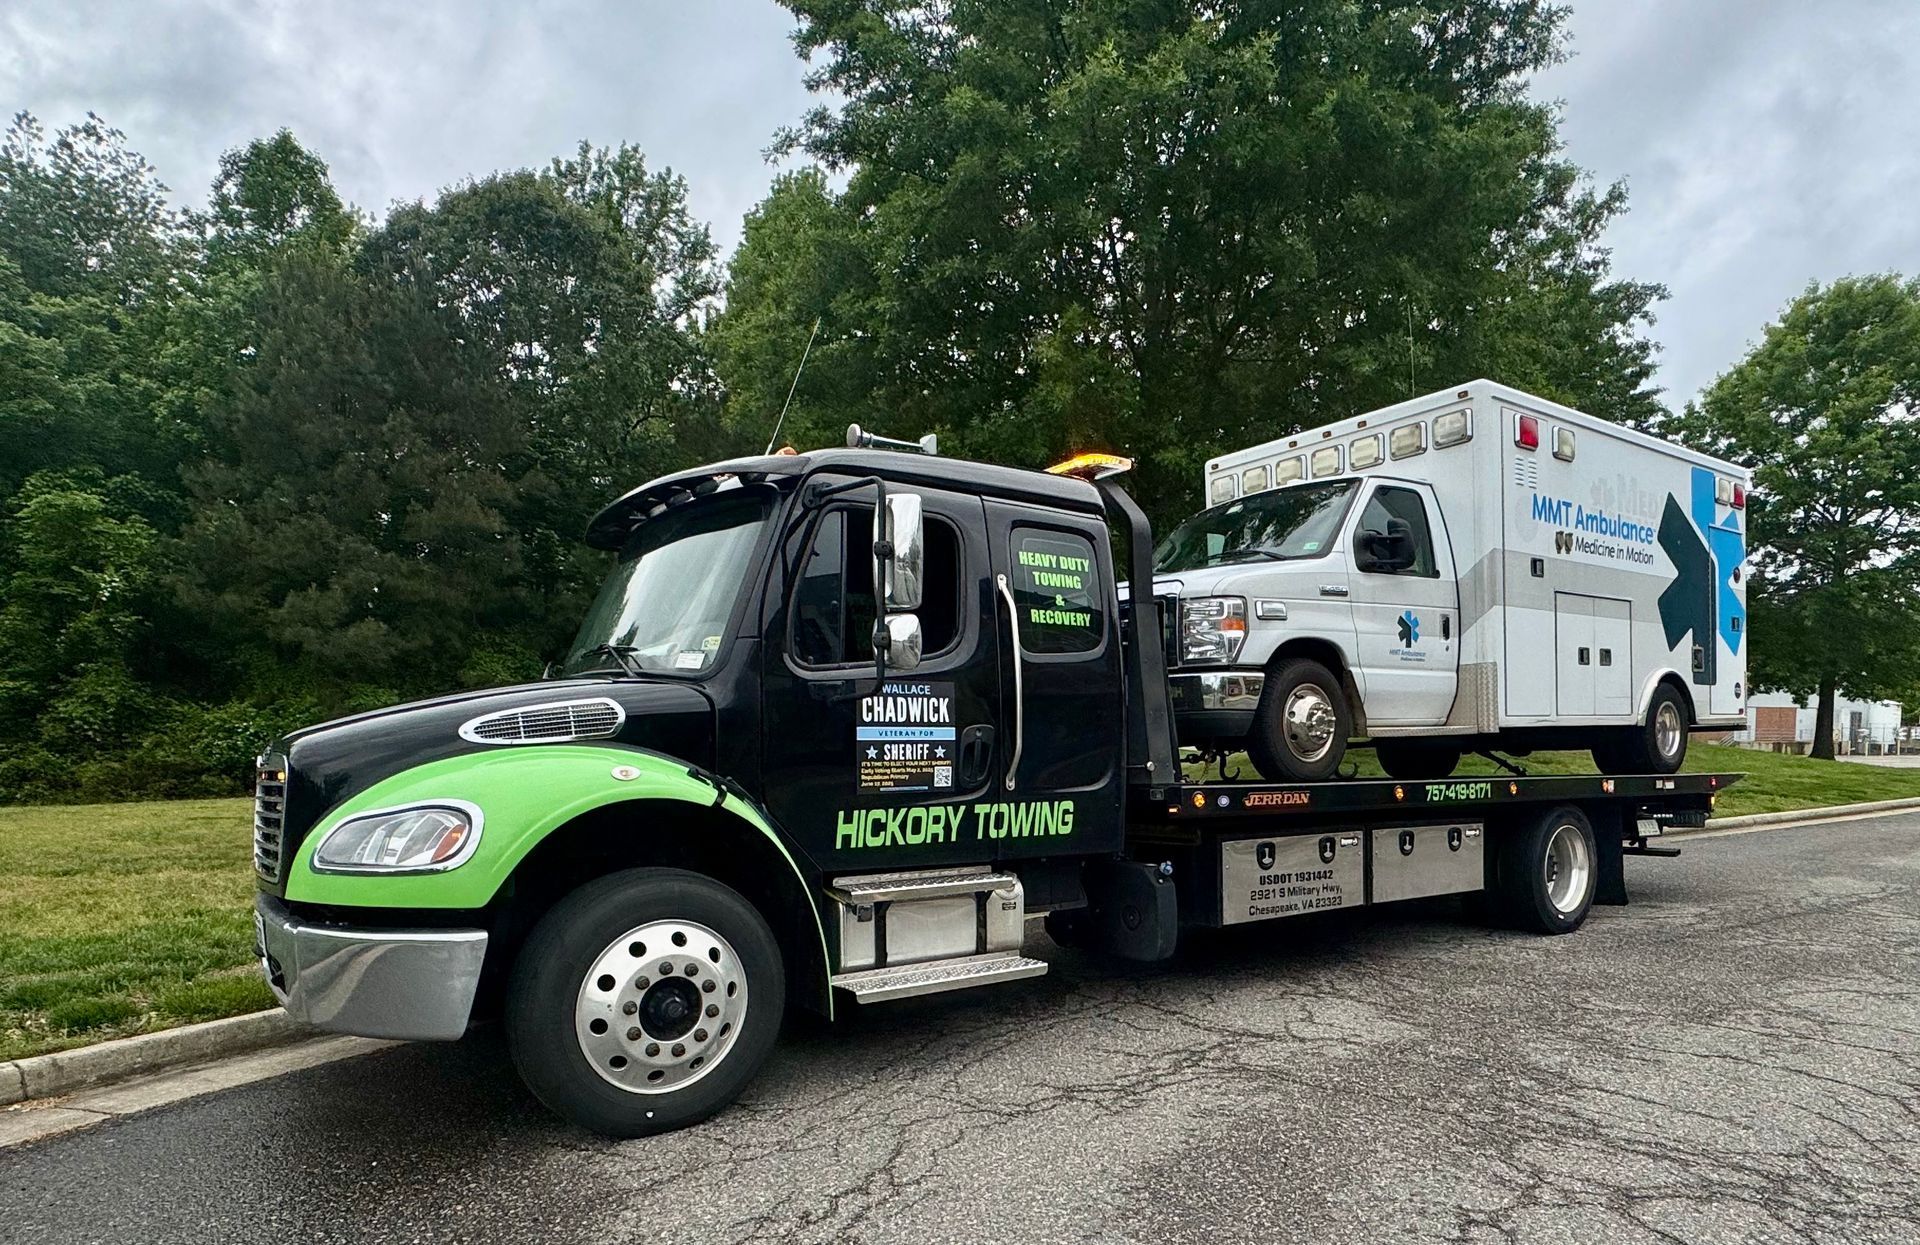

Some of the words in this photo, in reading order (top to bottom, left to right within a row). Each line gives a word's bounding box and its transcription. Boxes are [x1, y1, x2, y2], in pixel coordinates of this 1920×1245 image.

[1532, 493, 1573, 528] MMT
[1574, 505, 1654, 545] Ambulance
[1574, 535, 1616, 559] Medicine
[1616, 548, 1625, 561] in
[1626, 551, 1654, 566] Motion
[1018, 551, 1057, 569] HEAVY
[1059, 556, 1089, 573] DUTY
[1032, 571, 1082, 590] TOWING
[1055, 594, 1065, 607] &
[1030, 608, 1091, 627] RECOVERY
[882, 684, 931, 695] WALLACE
[862, 696, 950, 723] CHADWICK
[883, 743, 930, 760] SHERIFF
[835, 805, 966, 849] HICKORY
[974, 800, 1074, 840] TOWING
[1259, 873, 1293, 886] USDOT
[1294, 870, 1333, 882] 1931442
[1250, 888, 1276, 901] 2921
[1279, 887, 1286, 898] S
[1287, 885, 1320, 896] Military
[1249, 903, 1300, 916] Chesapeake,
[1301, 900, 1314, 910] VA
[1315, 896, 1343, 908] 23323
